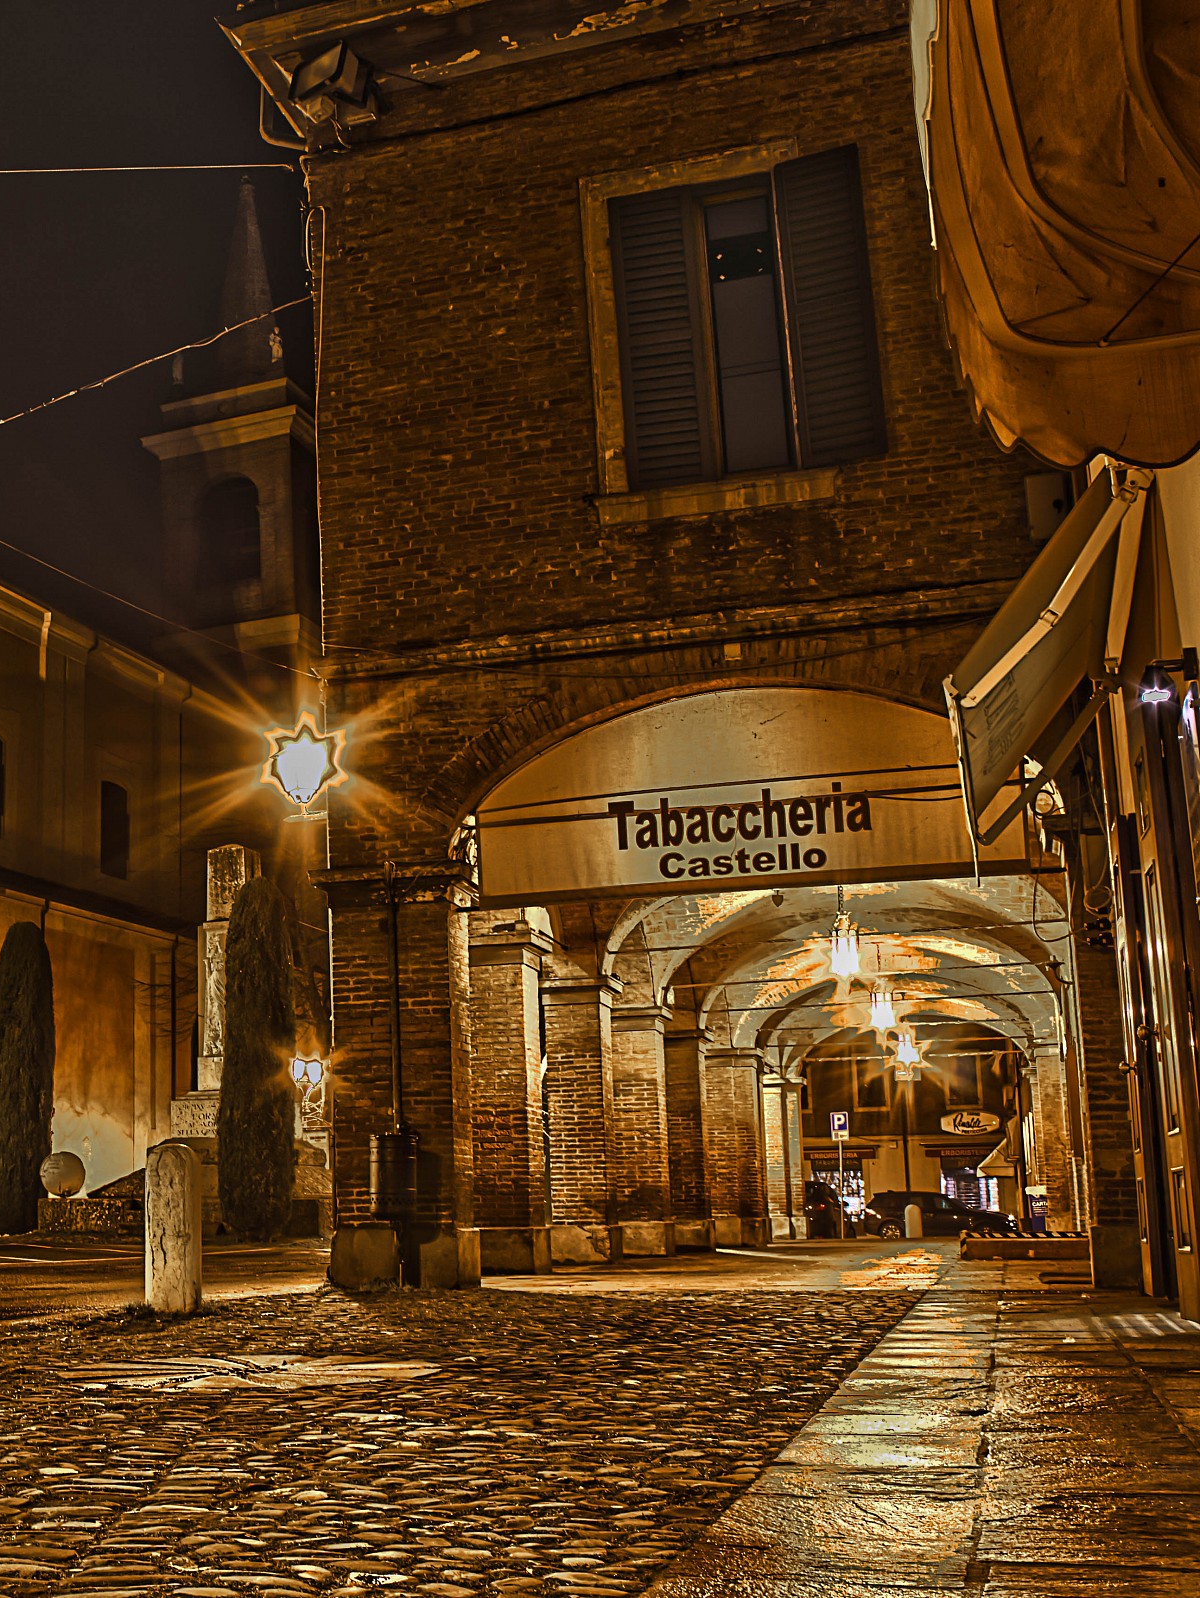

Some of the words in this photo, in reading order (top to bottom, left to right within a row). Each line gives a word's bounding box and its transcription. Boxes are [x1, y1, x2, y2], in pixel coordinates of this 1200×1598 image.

[608, 782, 873, 850] Tabaccheria
[659, 843, 828, 879] Castello
[833, 1114, 846, 1130] P
[810, 1152, 858, 1160] ERBORISERIA
